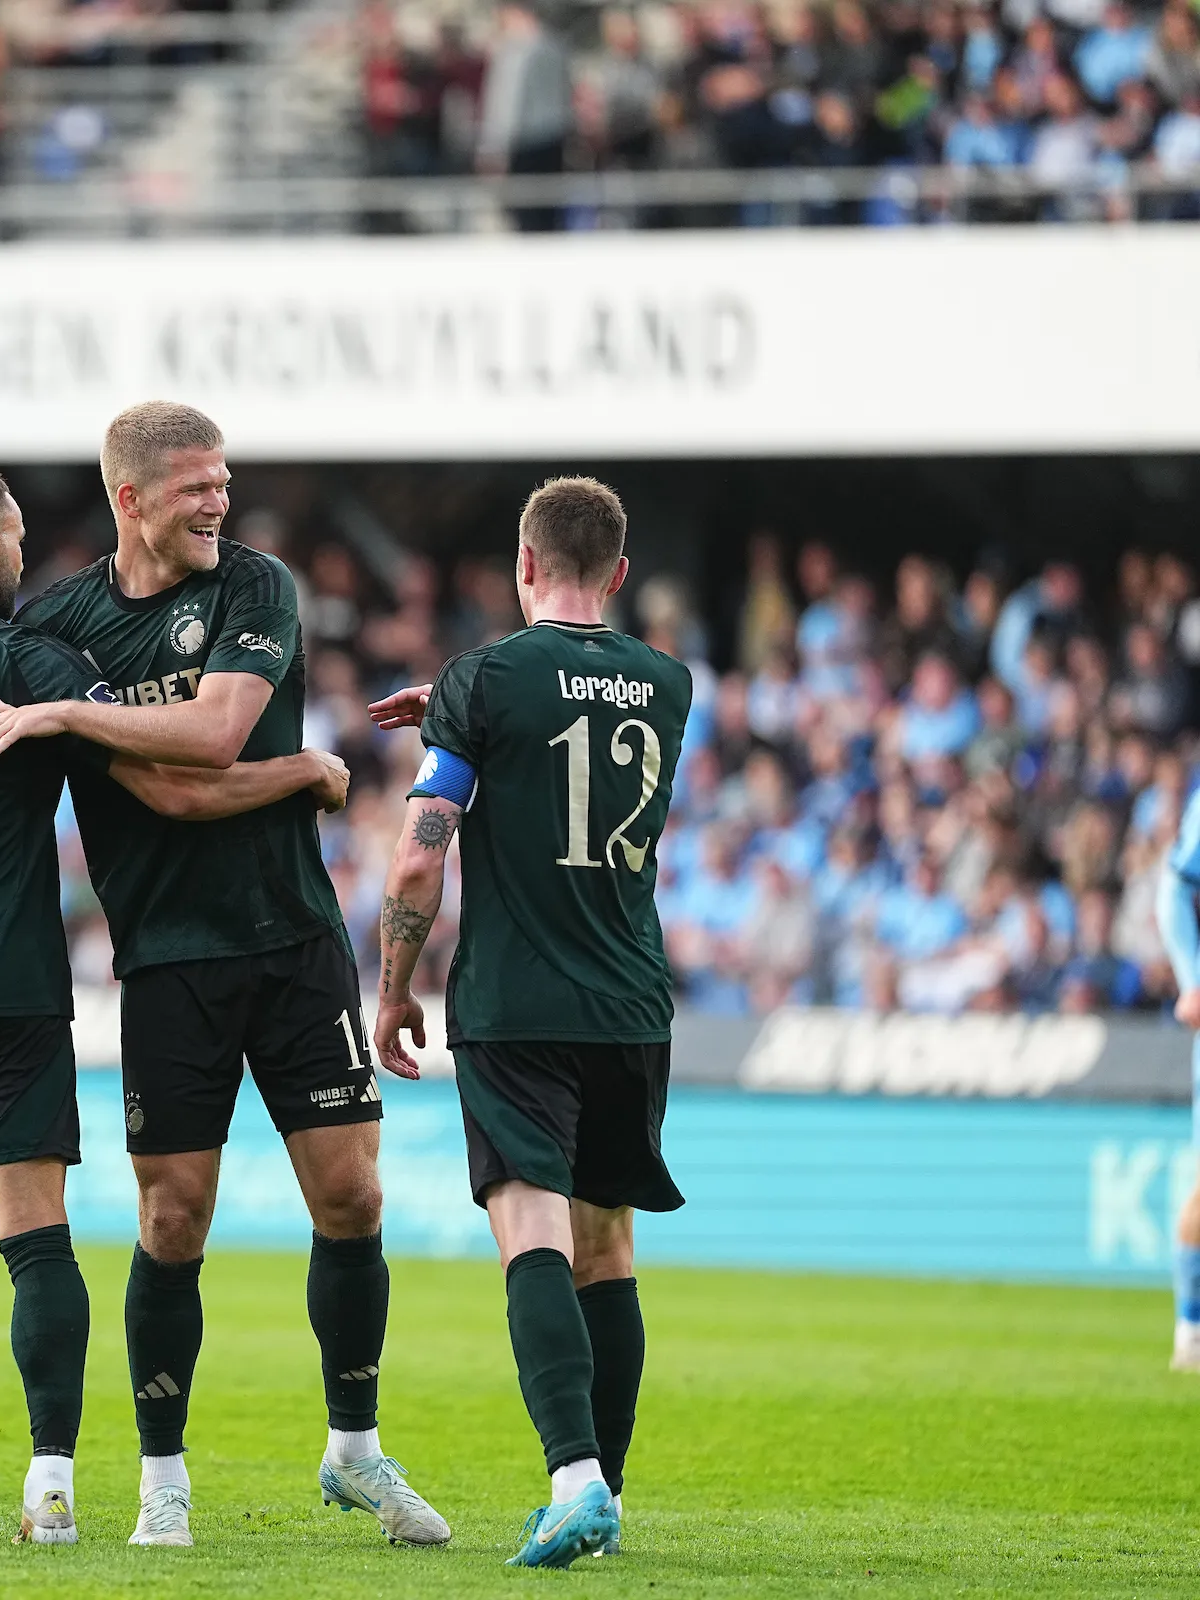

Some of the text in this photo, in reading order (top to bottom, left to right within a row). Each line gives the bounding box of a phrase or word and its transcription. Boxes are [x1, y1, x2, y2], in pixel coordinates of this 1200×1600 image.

[152, 290, 762, 398] KRONJYLLAND
[557, 669, 654, 709] Lerager
[548, 715, 661, 873] 12
[310, 1085, 356, 1103] UNIBET
